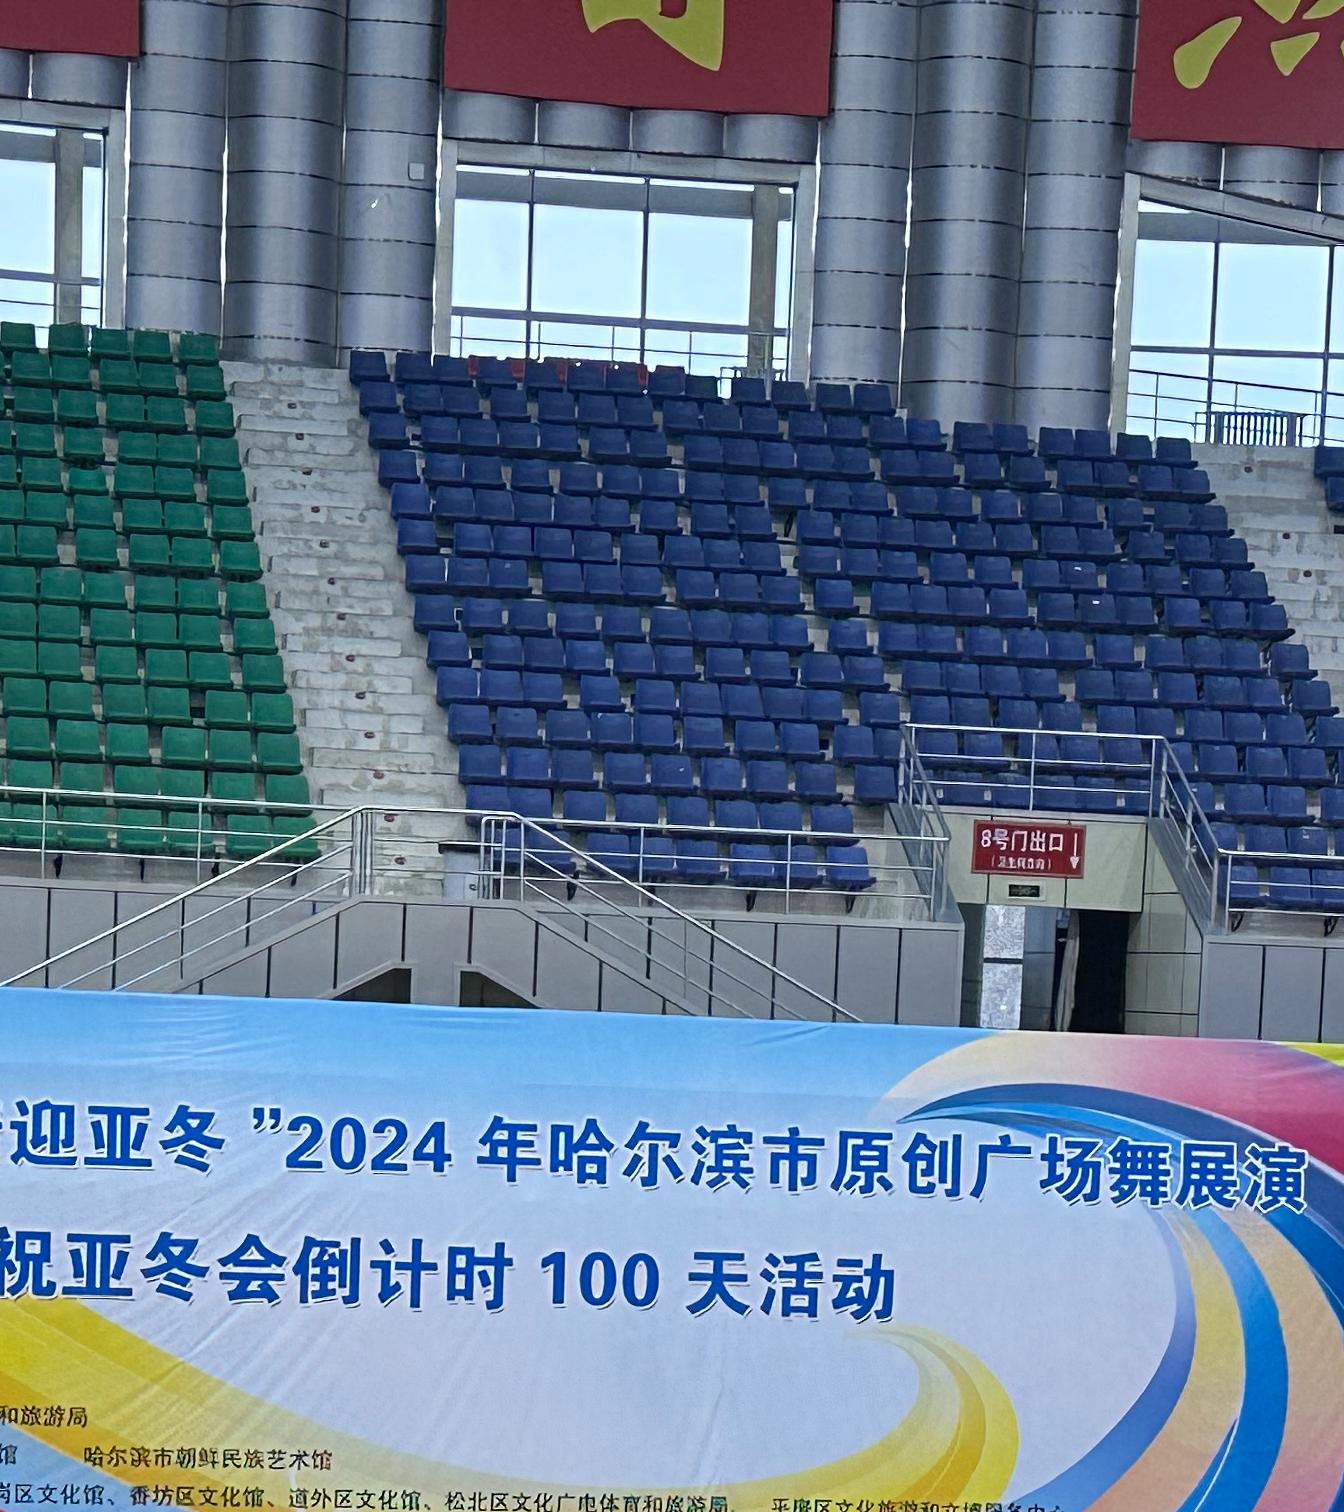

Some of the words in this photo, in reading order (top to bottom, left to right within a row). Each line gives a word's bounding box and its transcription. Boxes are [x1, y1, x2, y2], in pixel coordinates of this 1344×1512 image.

[981, 828, 1064, 852] 8号门出口
[476, 1114, 1309, 1213] 年哈尔滨市原创广场舞展演
[540, 1251, 660, 1308] 100
[686, 1251, 896, 1322] 天活动
[83, 1446, 334, 1472] 哈尔滨市朝鲜民族艺术馆
